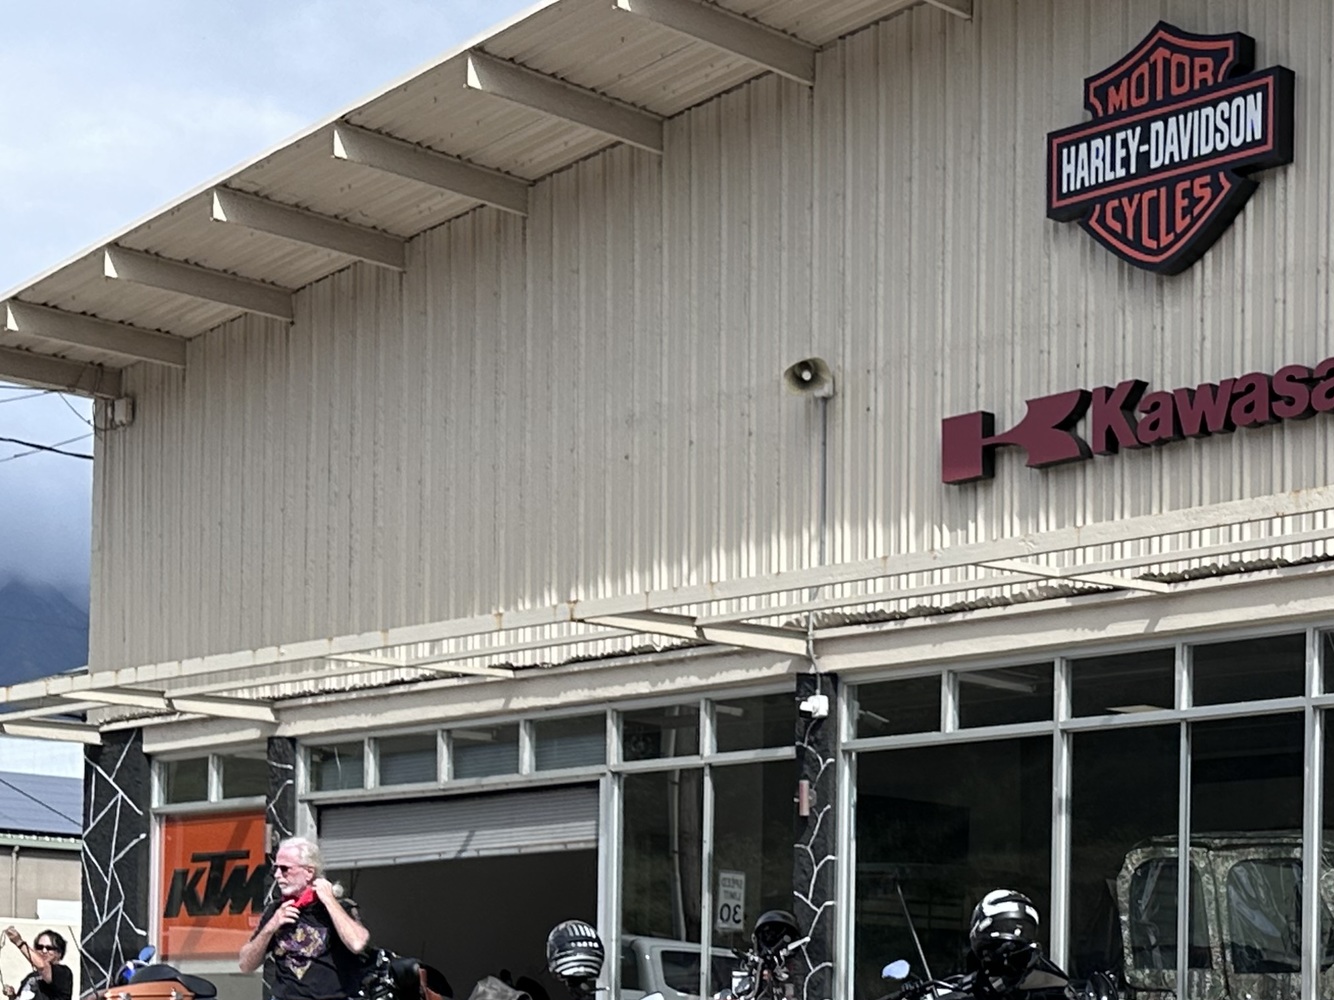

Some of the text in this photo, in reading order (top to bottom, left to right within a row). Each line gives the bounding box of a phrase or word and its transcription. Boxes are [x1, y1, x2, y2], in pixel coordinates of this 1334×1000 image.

[1107, 47, 1214, 115] MOTOR
[1061, 91, 1263, 194] HARLEY-DAVIDSON
[1105, 175, 1213, 249] CYCLES
[163, 850, 268, 918] KTM
